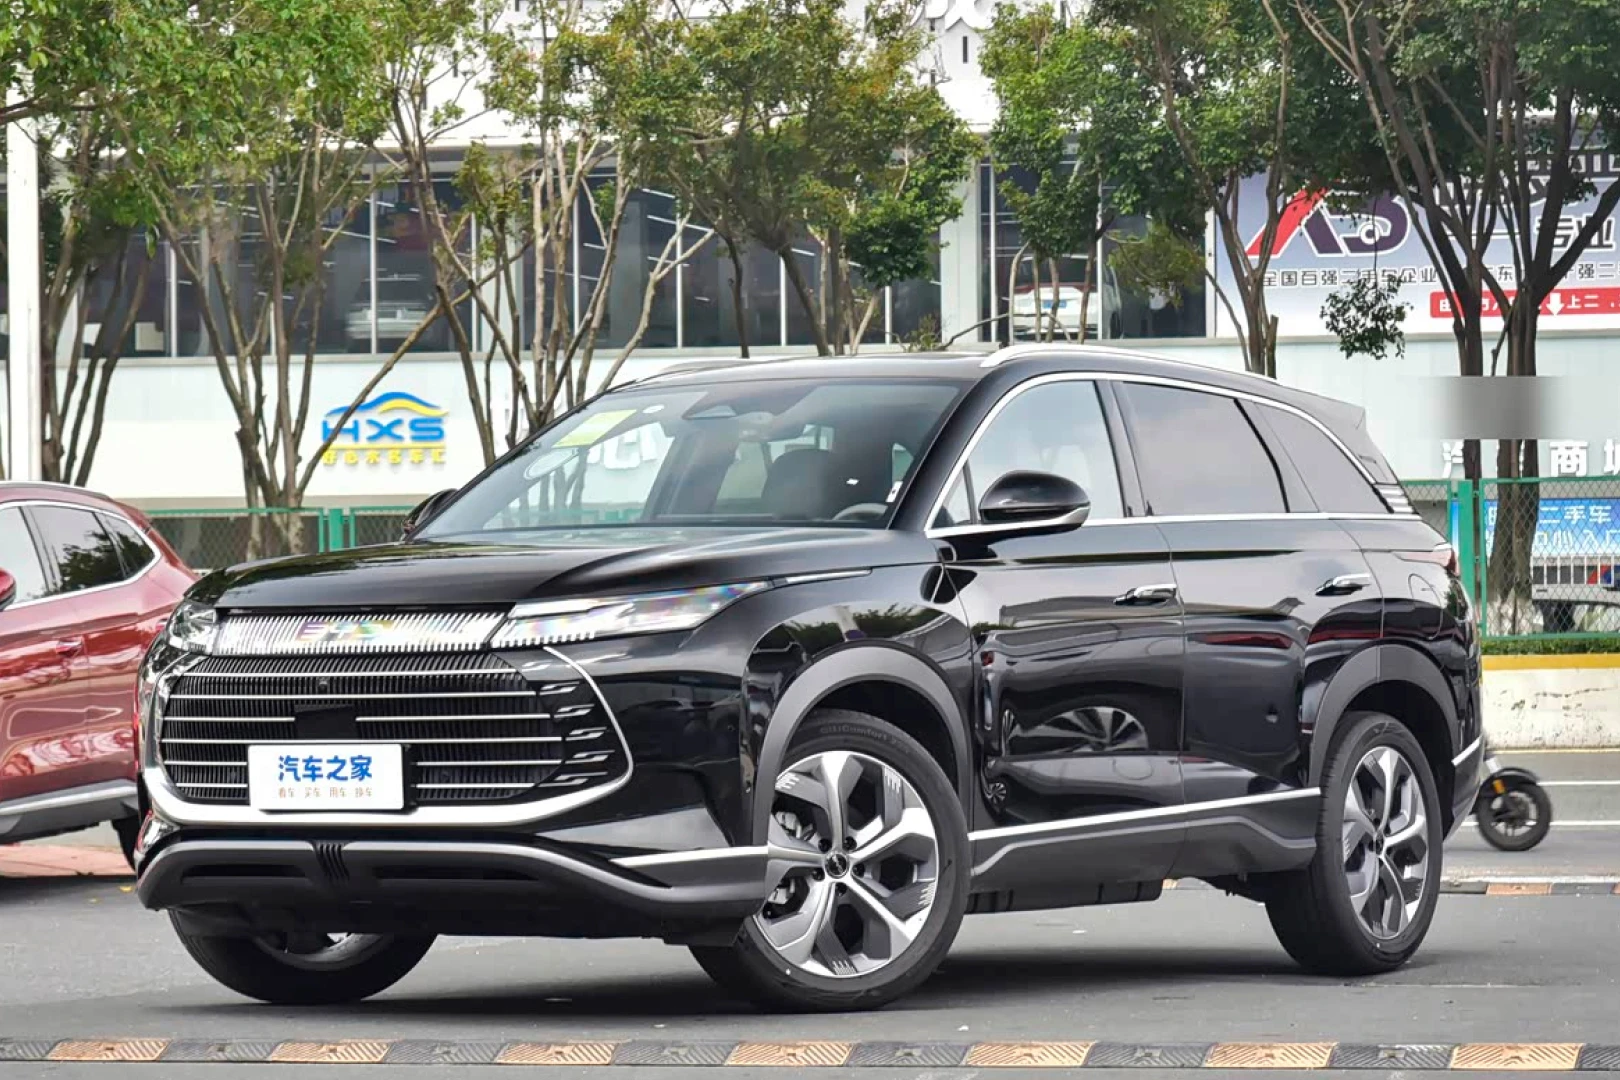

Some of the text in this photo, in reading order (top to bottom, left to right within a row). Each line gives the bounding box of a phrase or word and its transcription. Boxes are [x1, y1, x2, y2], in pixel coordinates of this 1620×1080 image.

[321, 417, 445, 442] HXS
[278, 755, 373, 782] 汽车之家
